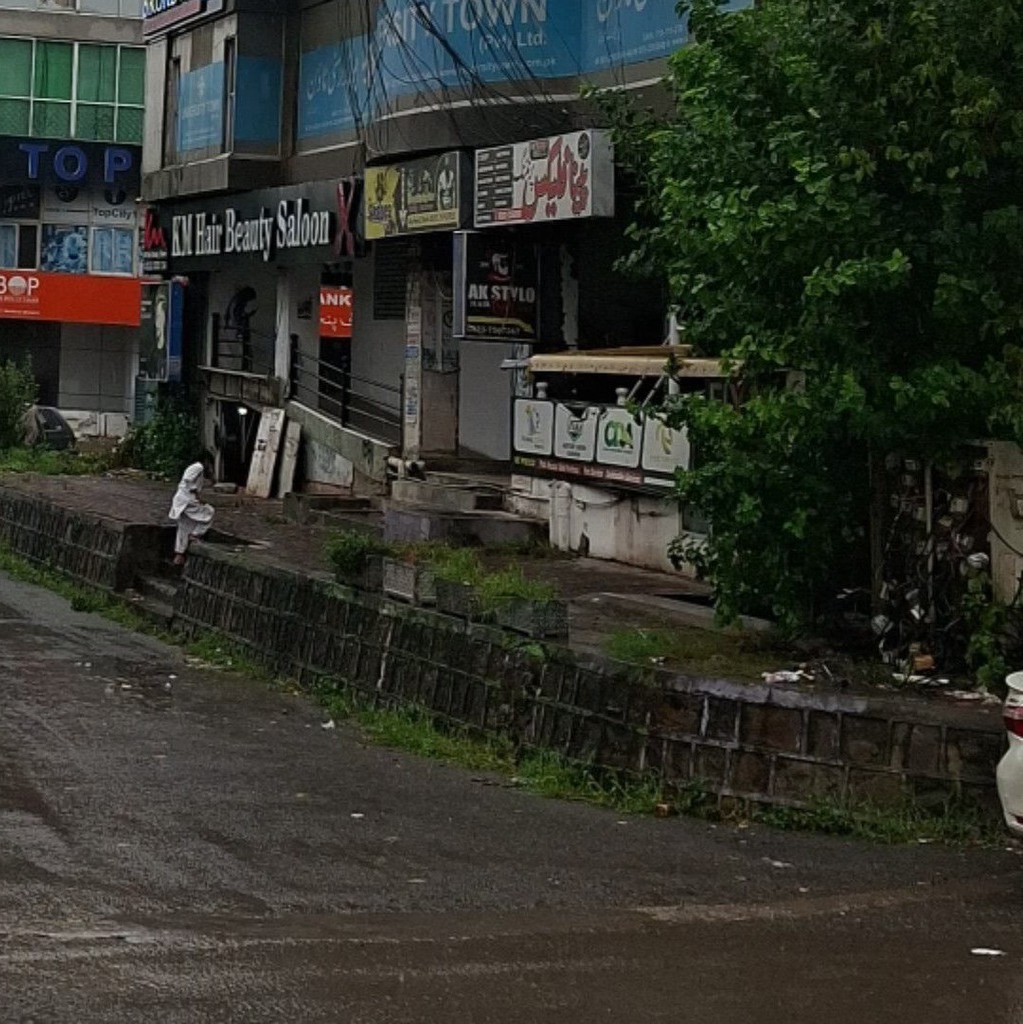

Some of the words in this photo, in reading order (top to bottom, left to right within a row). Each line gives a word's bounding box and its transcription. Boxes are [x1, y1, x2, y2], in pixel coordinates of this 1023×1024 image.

[18, 143, 132, 184] TOP
[171, 214, 193, 257] KM
[195, 211, 223, 256] Hair
[224, 207, 274, 263] Beauty
[276, 197, 329, 249] Saloon
[468, 283, 488, 300] AK
[491, 284, 536, 304] STYLO
